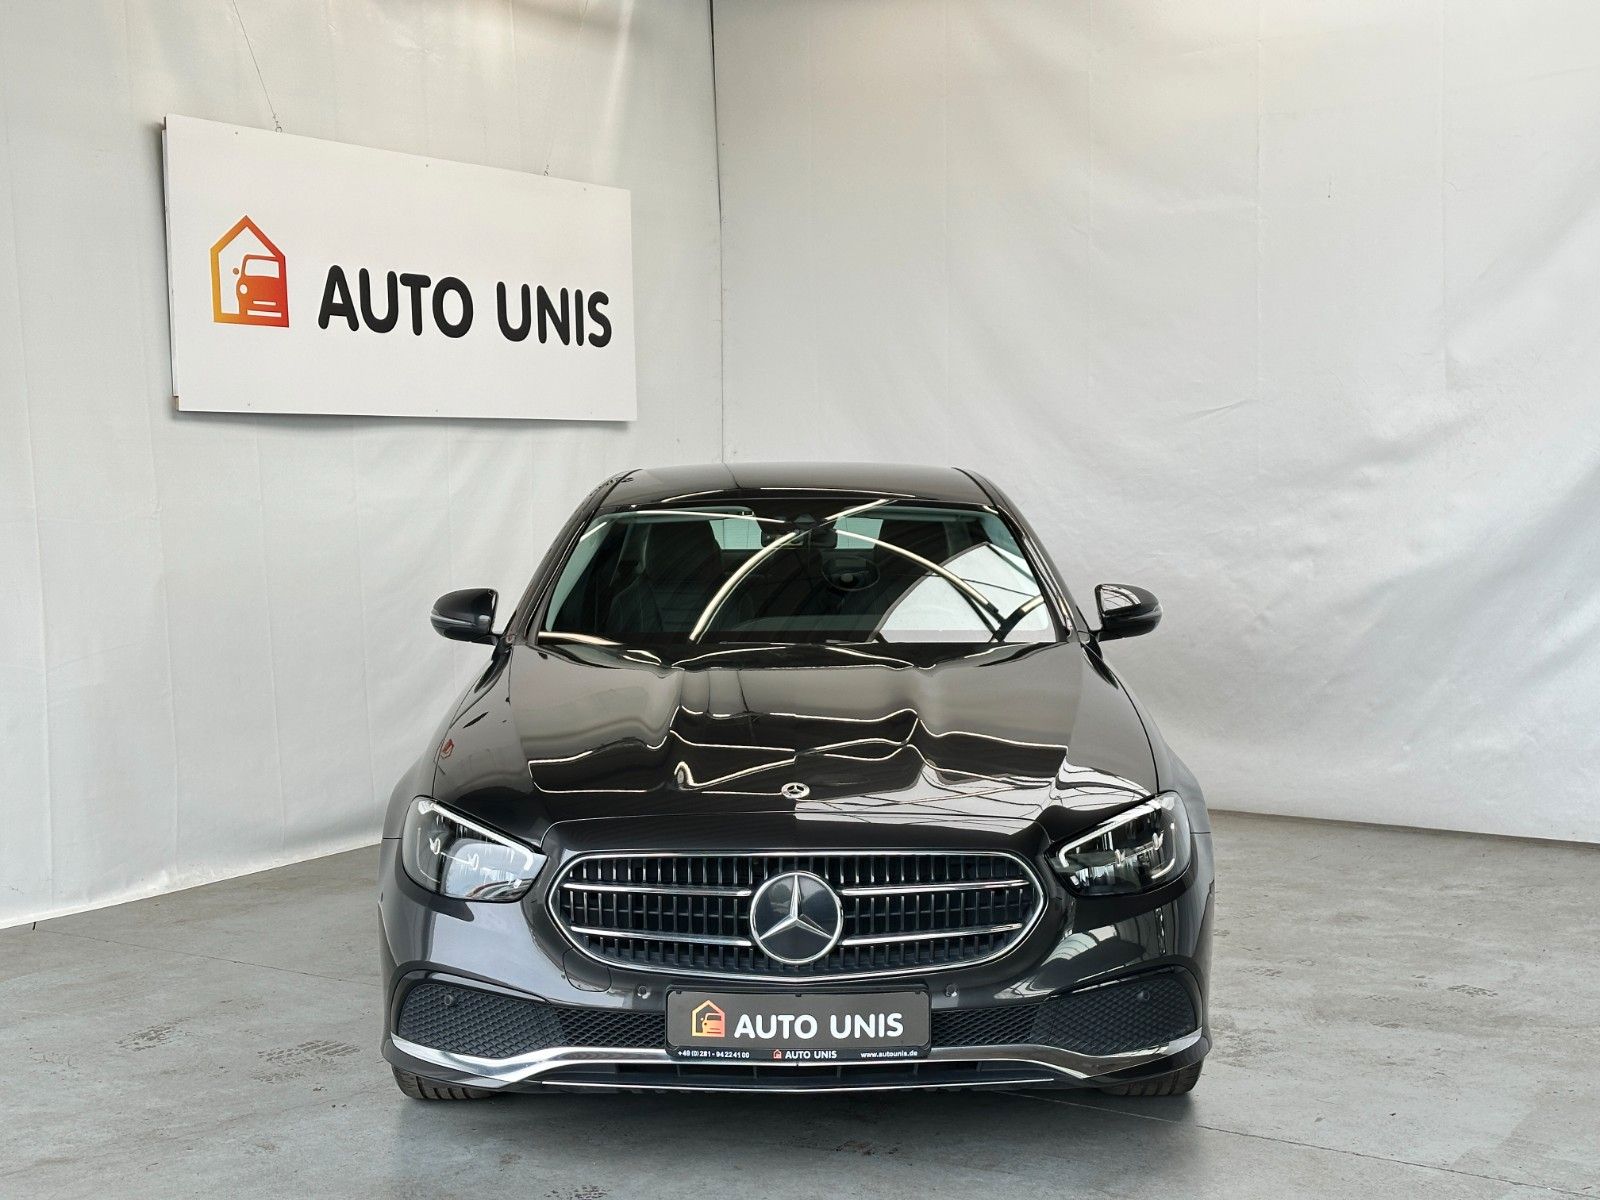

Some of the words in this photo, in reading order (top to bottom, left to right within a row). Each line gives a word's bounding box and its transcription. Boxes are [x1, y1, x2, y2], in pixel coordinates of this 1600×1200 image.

[318, 265, 474, 338] AUTO
[496, 281, 613, 348] UNIS
[734, 1014, 818, 1039] AUTO
[830, 1013, 904, 1039] UNIS
[785, 1050, 811, 1059] AUTO
[814, 1050, 838, 1059] UNIS
[861, 1050, 918, 1058] www.autounis.de
